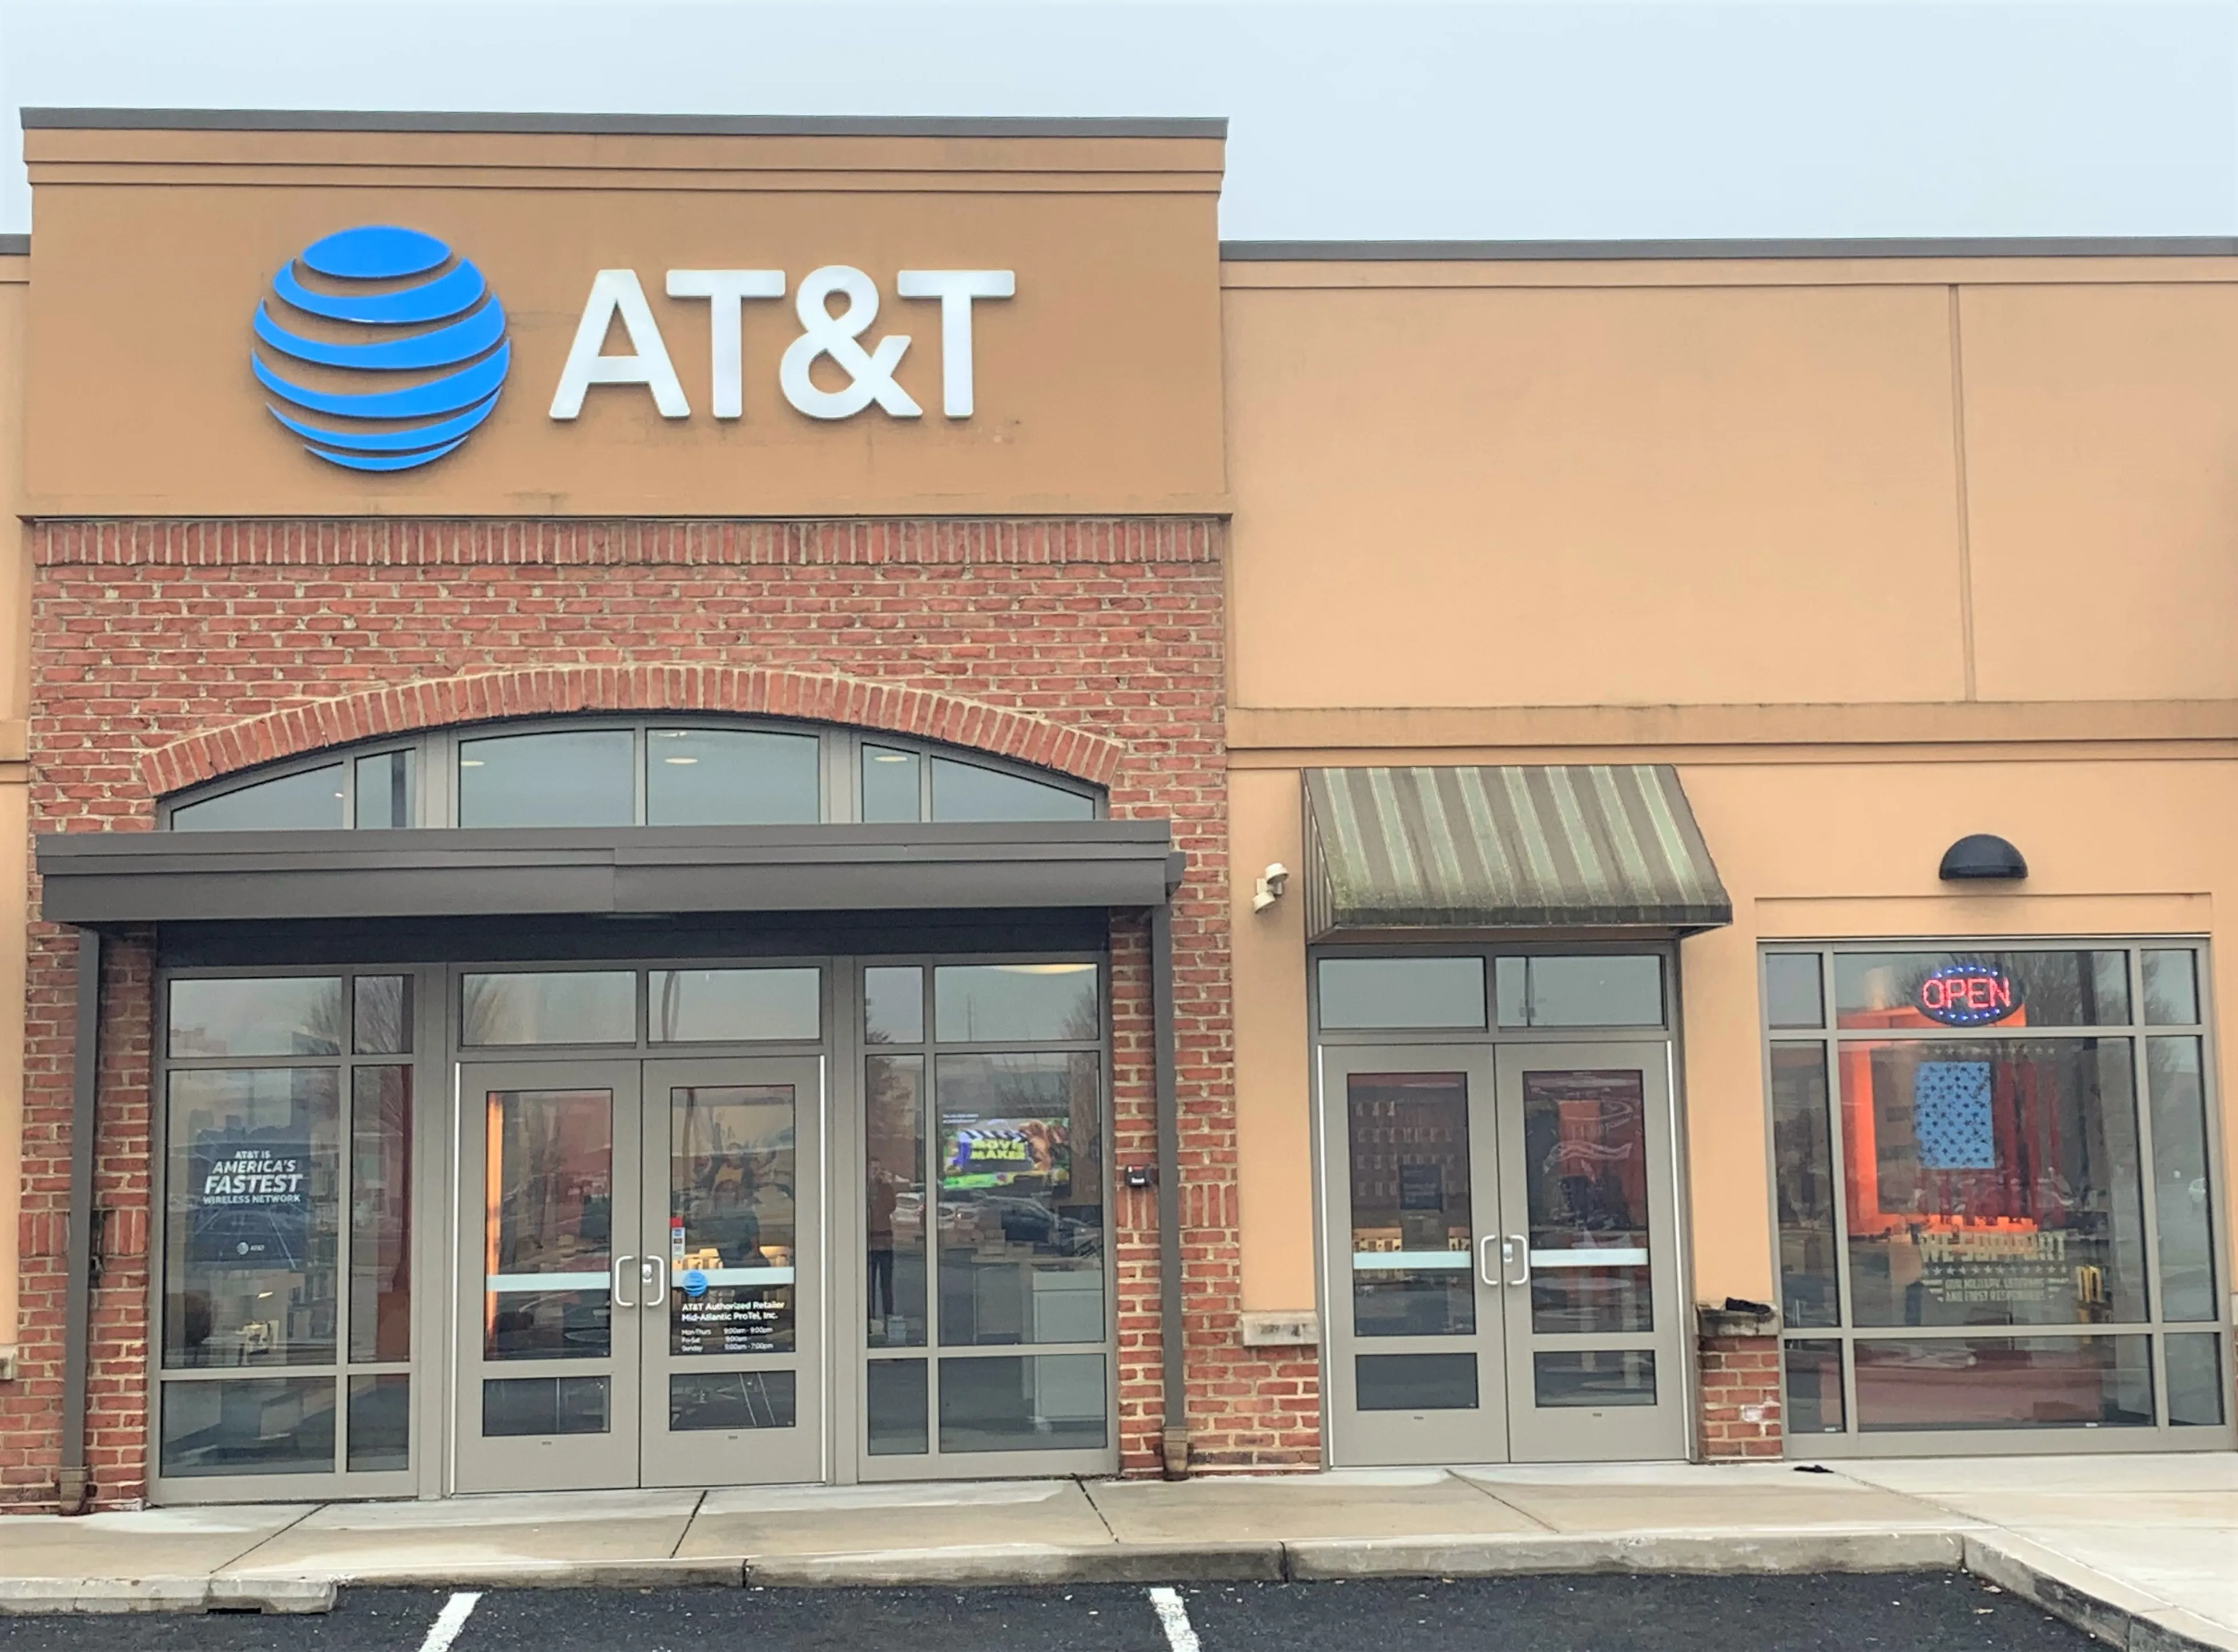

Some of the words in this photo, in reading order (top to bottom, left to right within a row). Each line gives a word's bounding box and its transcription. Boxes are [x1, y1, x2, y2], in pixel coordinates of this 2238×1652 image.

[549, 265, 1015, 420] AT&T
[1922, 977, 2011, 1009] OPEN
[234, 1150, 259, 1159] AT&T
[261, 1150, 271, 1159] IS
[212, 1159, 296, 1174] AMERICA'S
[204, 1174, 304, 1194] FASTEST
[203, 1195, 250, 1204] WIRELESS
[252, 1194, 301, 1203] NETWORK
[682, 1303, 704, 1311] AT&T
[705, 1302, 751, 1311] Authorized
